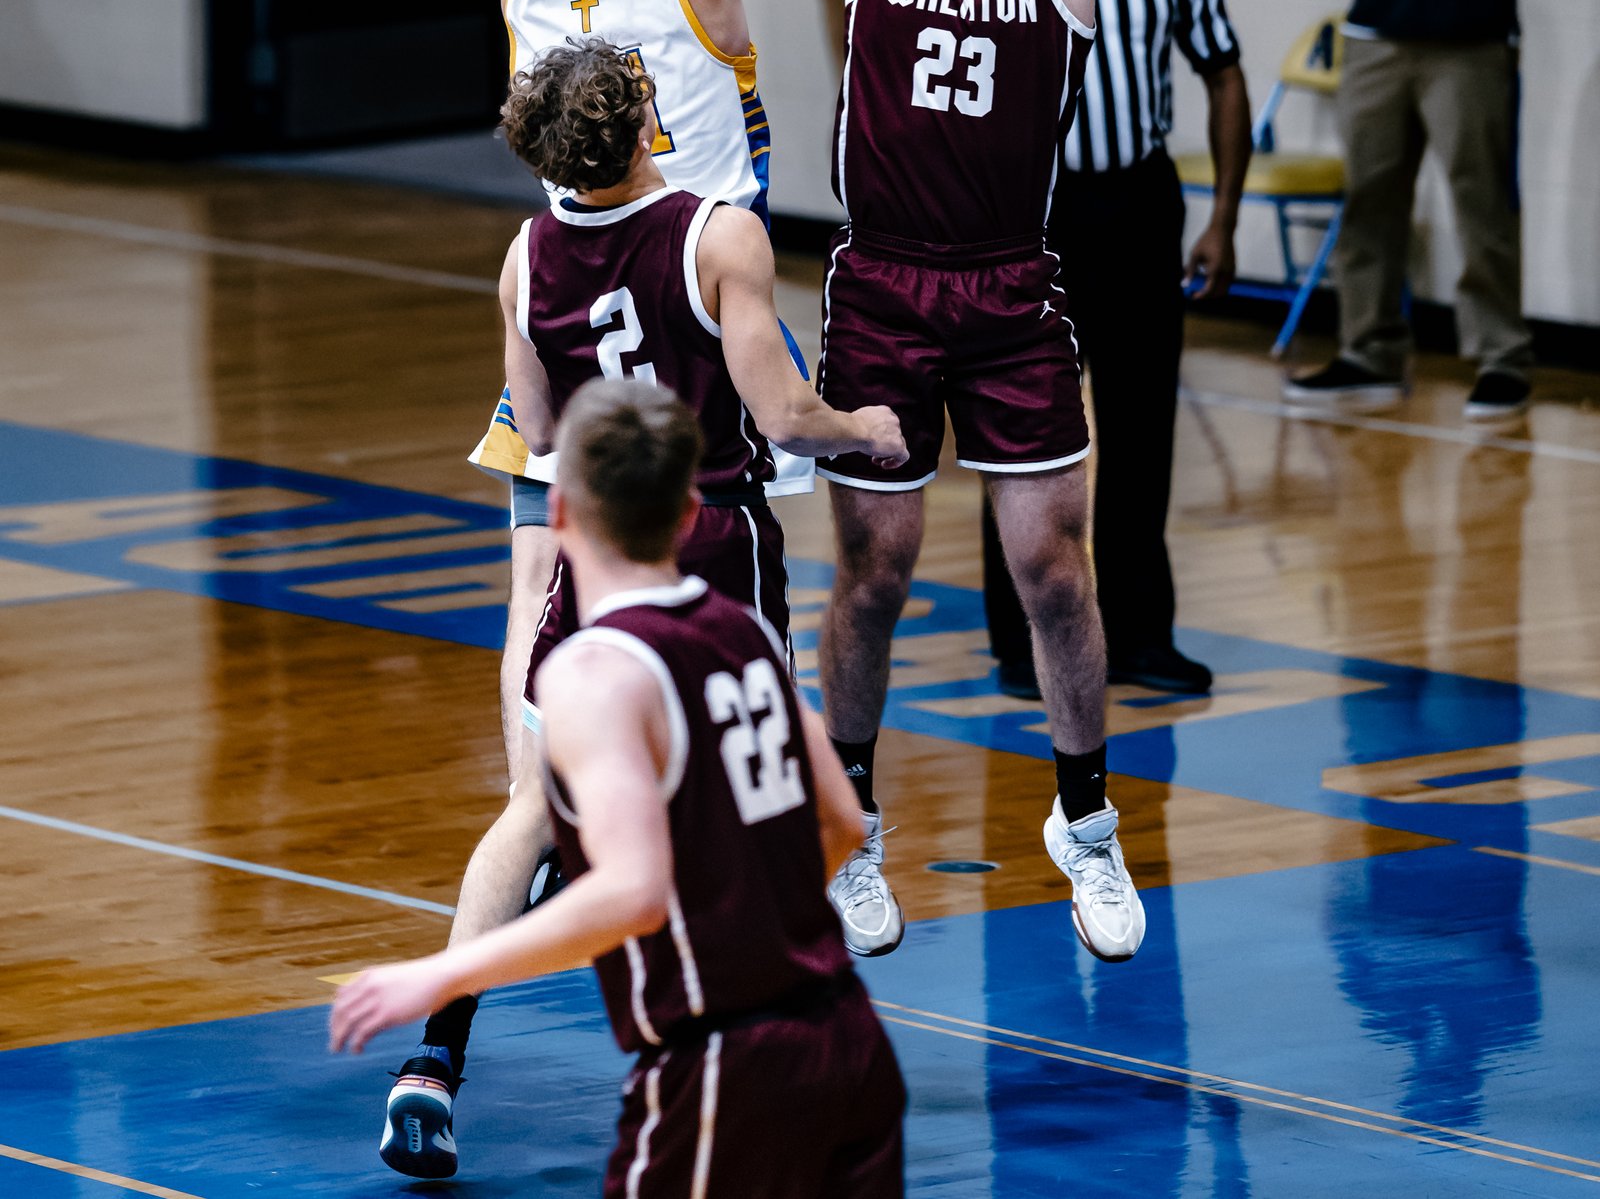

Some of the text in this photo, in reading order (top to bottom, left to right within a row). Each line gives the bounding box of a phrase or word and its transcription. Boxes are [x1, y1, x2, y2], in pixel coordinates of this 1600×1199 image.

[911, 26, 997, 118] 23
[589, 286, 657, 388] 2
[704, 656, 806, 826] 22
